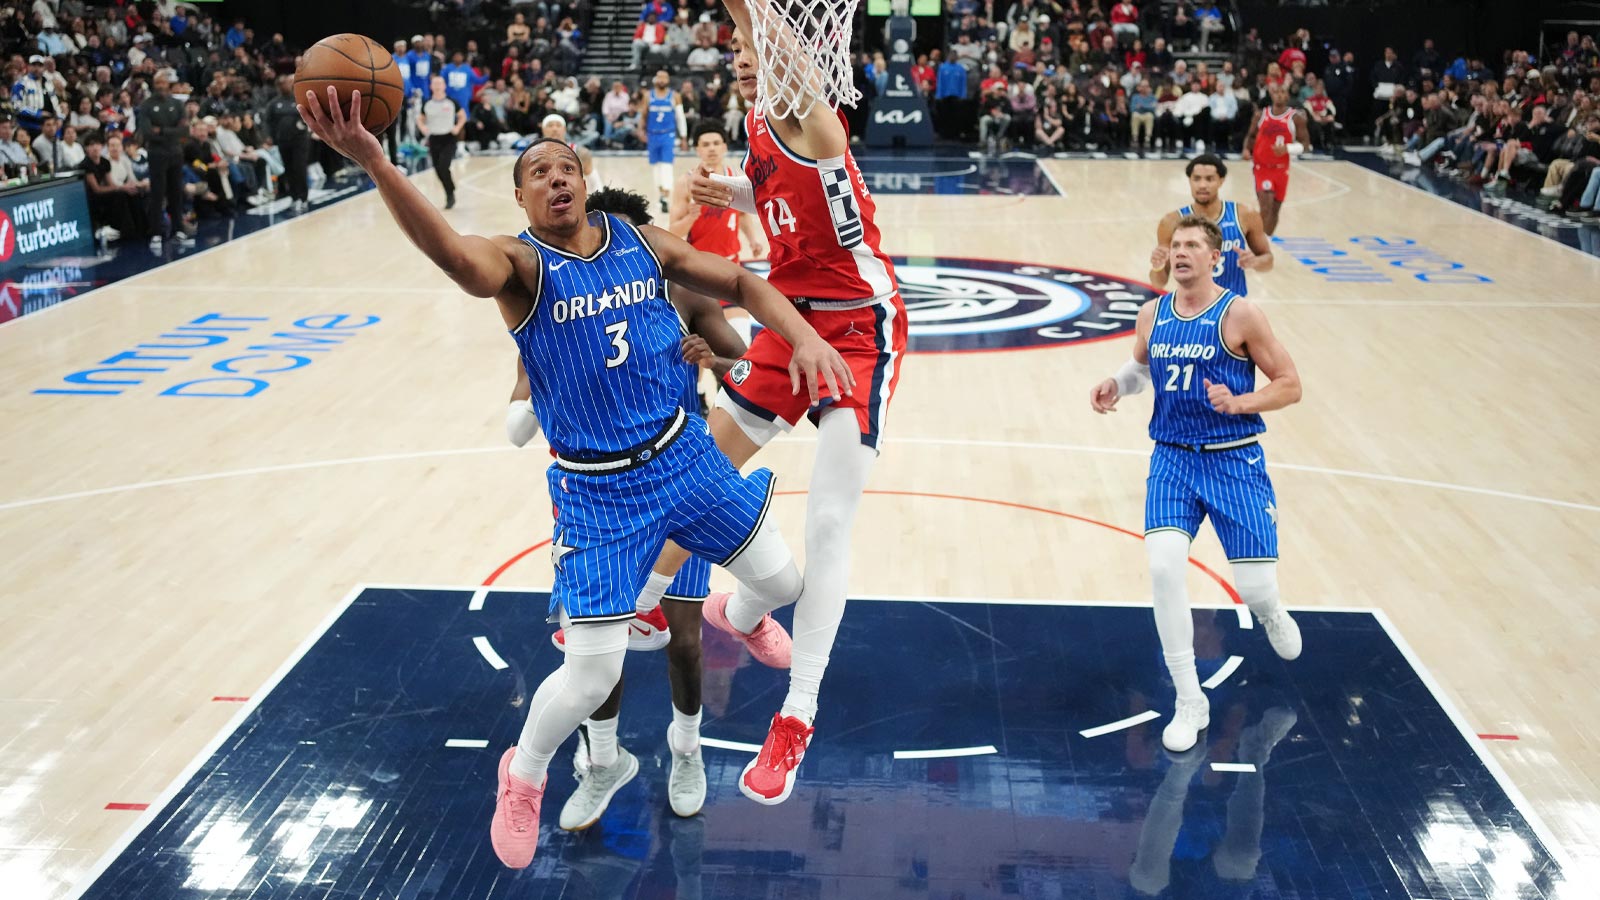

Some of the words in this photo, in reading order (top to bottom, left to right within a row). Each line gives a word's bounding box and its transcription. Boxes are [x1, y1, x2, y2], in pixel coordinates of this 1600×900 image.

[12, 198, 55, 226] INTUIT
[727, 212, 737, 231] 4
[16, 219, 80, 254] turbotax
[604, 319, 631, 369] 3
[1164, 363, 1195, 392] 21
